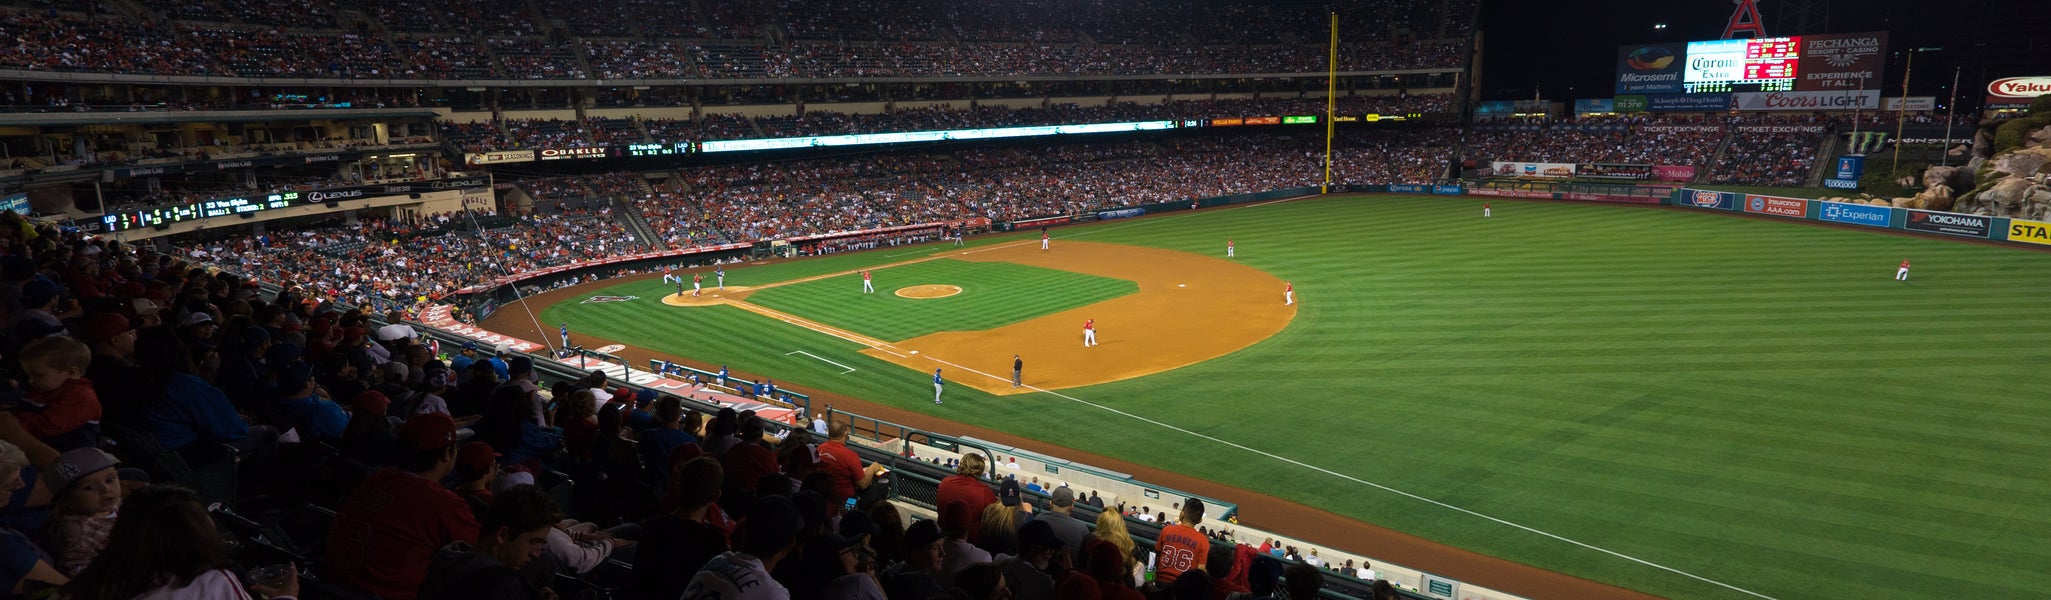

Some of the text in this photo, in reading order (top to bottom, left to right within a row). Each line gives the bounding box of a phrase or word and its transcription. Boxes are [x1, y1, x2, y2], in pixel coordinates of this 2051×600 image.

[1809, 37, 1879, 49] PECHANGA
[1692, 57, 1738, 70] Corona
[1621, 72, 1678, 82] Microsemi
[1703, 70, 1729, 78] Extra
[1766, 93, 1818, 108] Coors
[1820, 96, 1869, 107] LIGHT
[444, 179, 482, 188] LEXUS
[323, 190, 362, 199] LEXUS
[1768, 198, 1800, 206] Insurance
[1767, 207, 1800, 215] AAA.com
[1843, 209, 1884, 221] Experian
[1929, 214, 1983, 227] YOKOHAMA
[1165, 534, 1198, 550] WEAVER
[1162, 544, 1194, 572] 36
